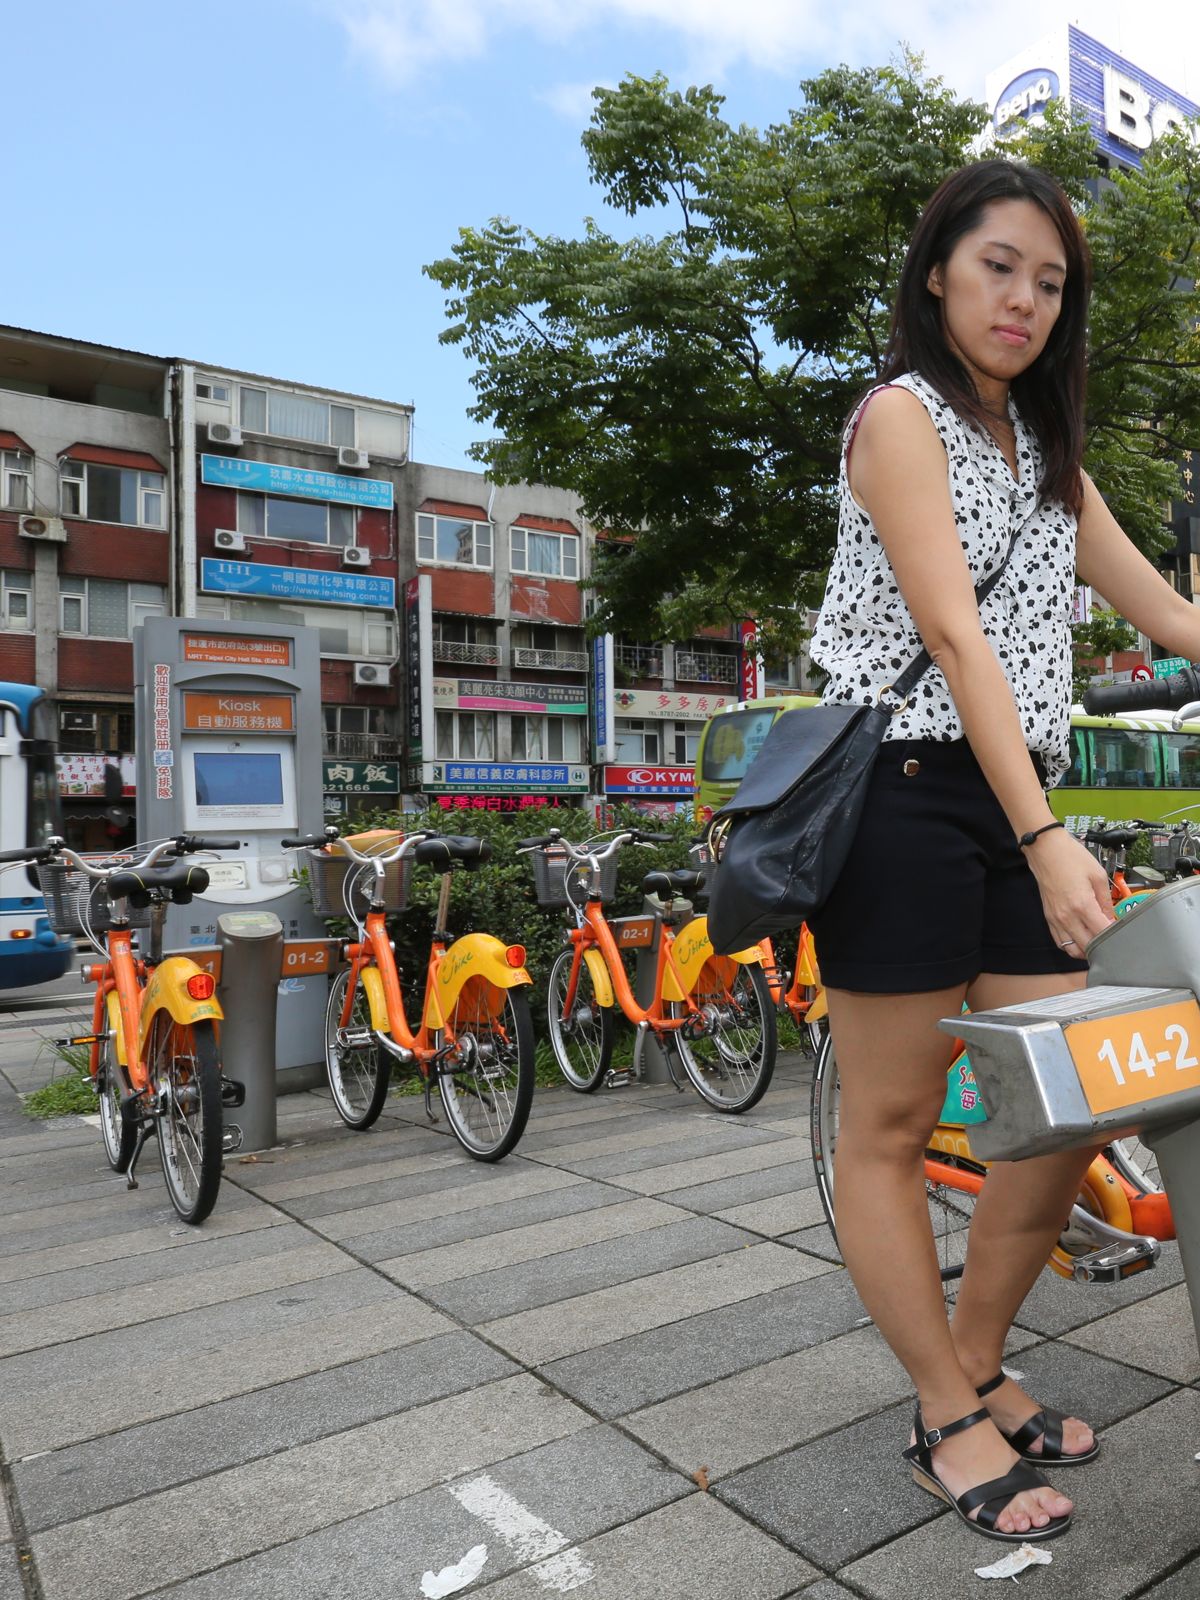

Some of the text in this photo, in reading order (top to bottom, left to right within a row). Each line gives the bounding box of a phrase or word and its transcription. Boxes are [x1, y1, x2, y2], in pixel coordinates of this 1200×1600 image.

[218, 698, 261, 712] Kiosk
[198, 715, 282, 729] 自動服務機
[327, 764, 394, 783] 肉飯
[449, 767, 565, 780] 美麗信義皮膚科診所
[655, 772, 697, 782] KYM
[158, 767, 172, 799] 免排隊
[622, 928, 649, 939] 02-1
[287, 951, 325, 965] 01-2
[1097, 1024, 1199, 1086] 14-2
